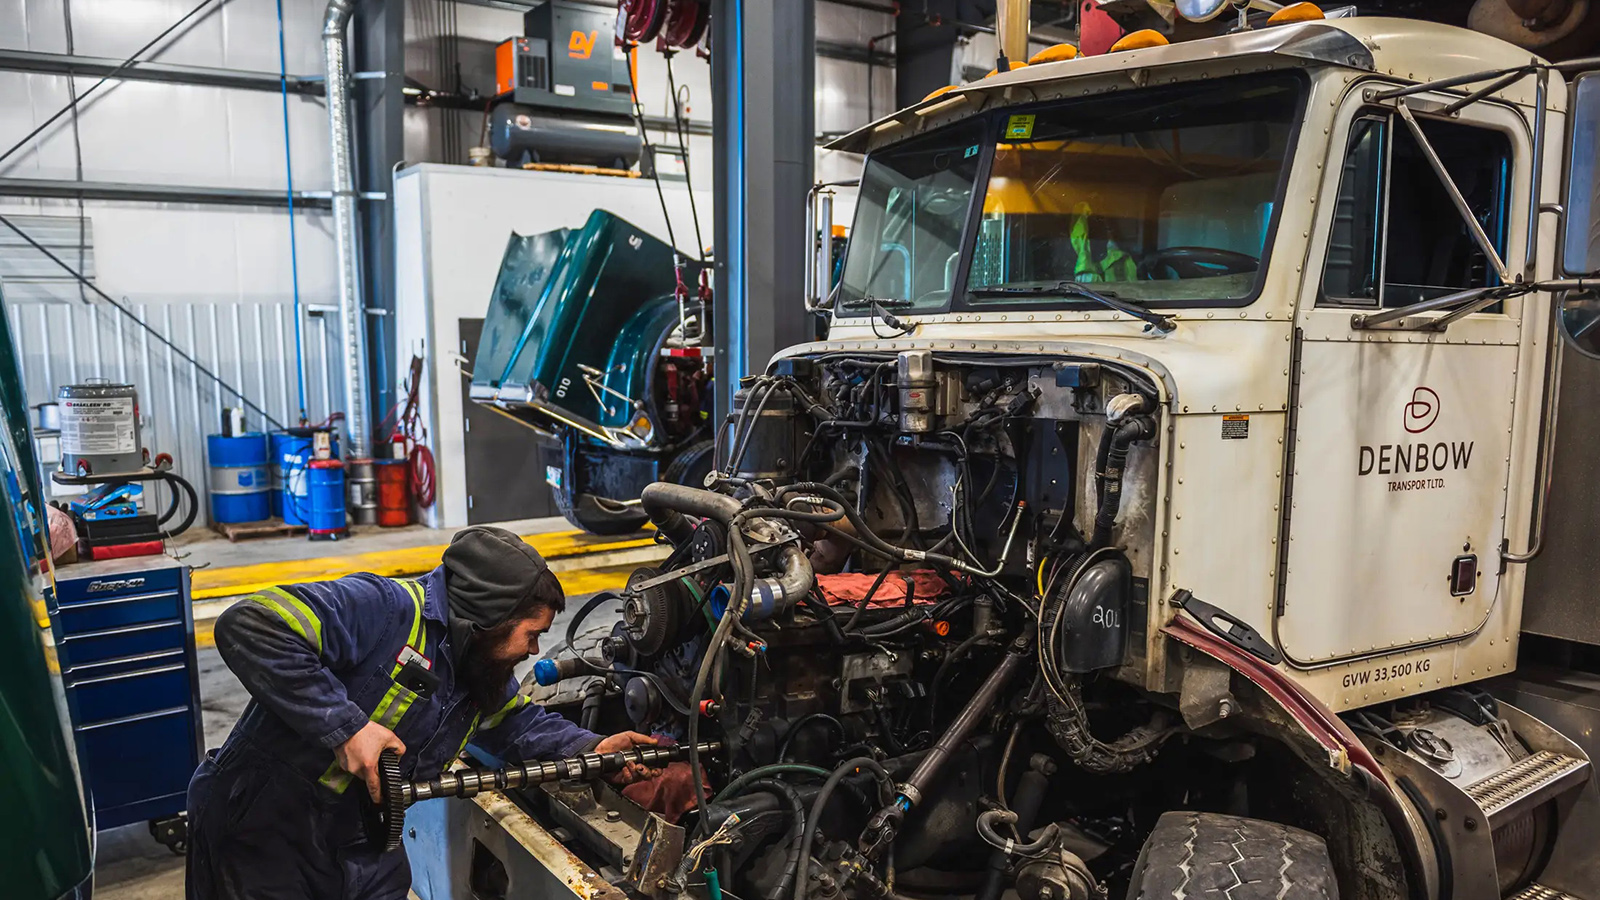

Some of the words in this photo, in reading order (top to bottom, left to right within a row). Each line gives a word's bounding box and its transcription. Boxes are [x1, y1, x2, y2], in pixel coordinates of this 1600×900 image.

[556, 377, 571, 398] 010
[1358, 441, 1474, 476] DENBOW
[1342, 671, 1371, 688] GVW
[1374, 663, 1412, 681] 33,500
[1415, 659, 1430, 673] KG
